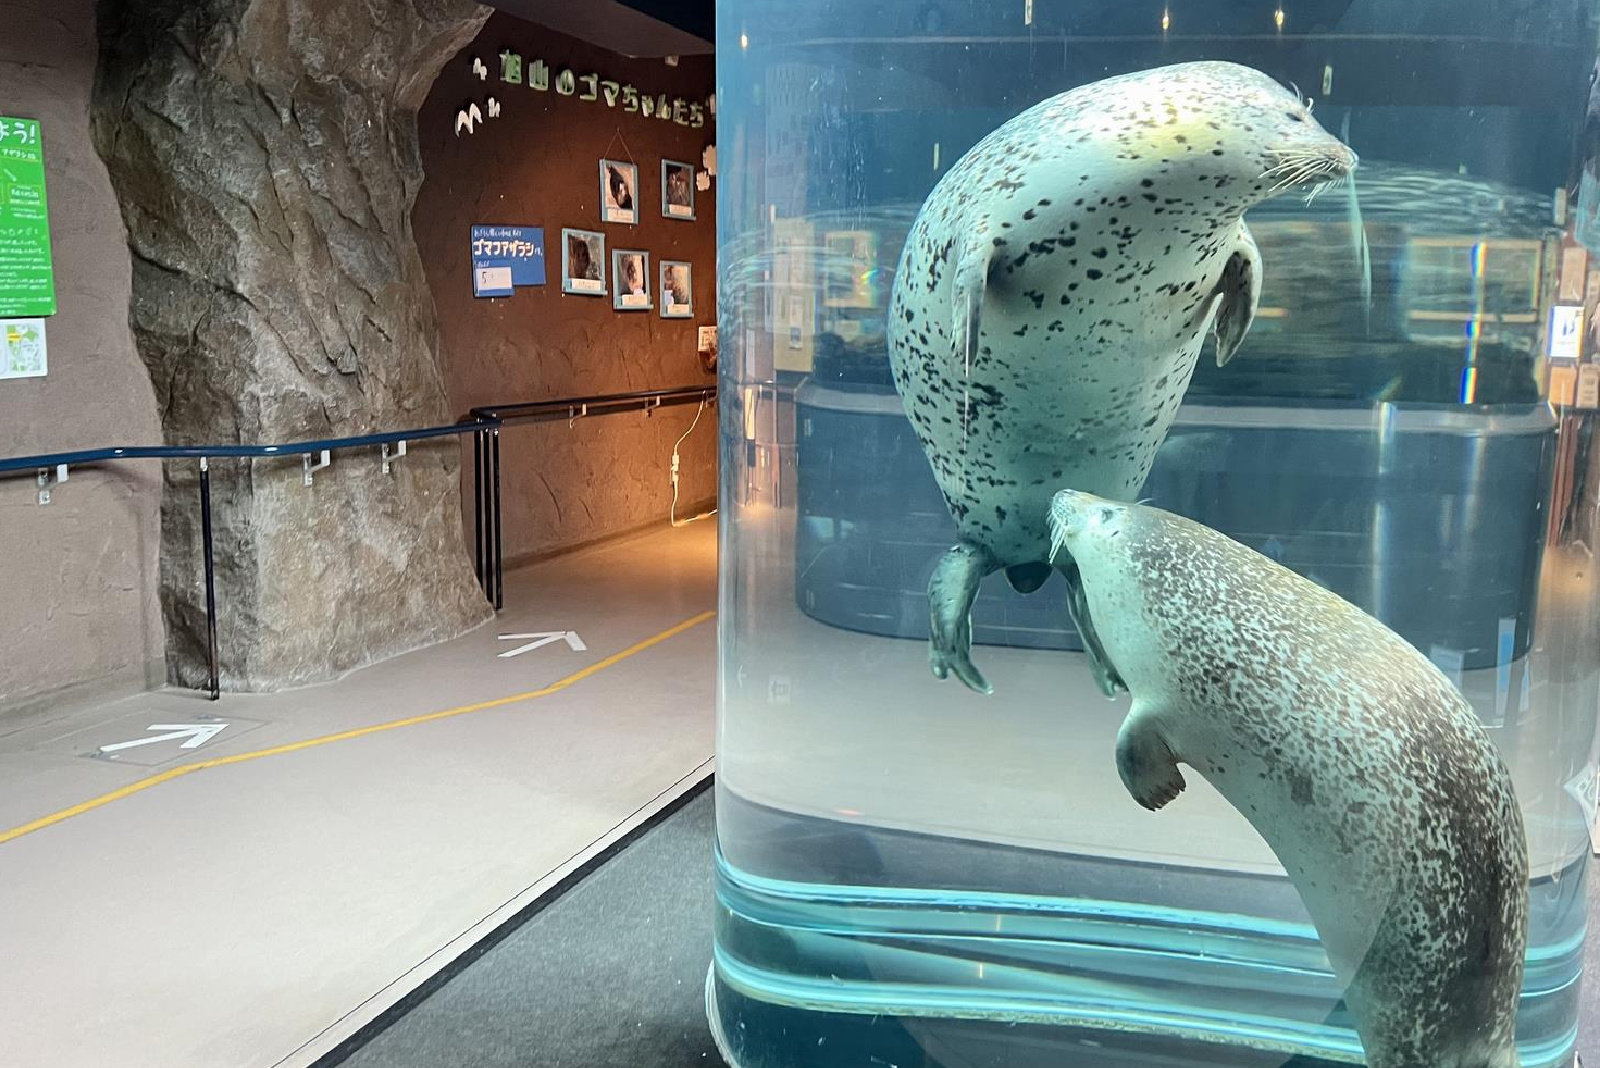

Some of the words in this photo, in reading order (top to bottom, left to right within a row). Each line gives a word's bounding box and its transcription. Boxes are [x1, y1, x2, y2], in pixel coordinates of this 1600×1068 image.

[499, 49, 704, 128] 旭山のゴマちゃんたち
